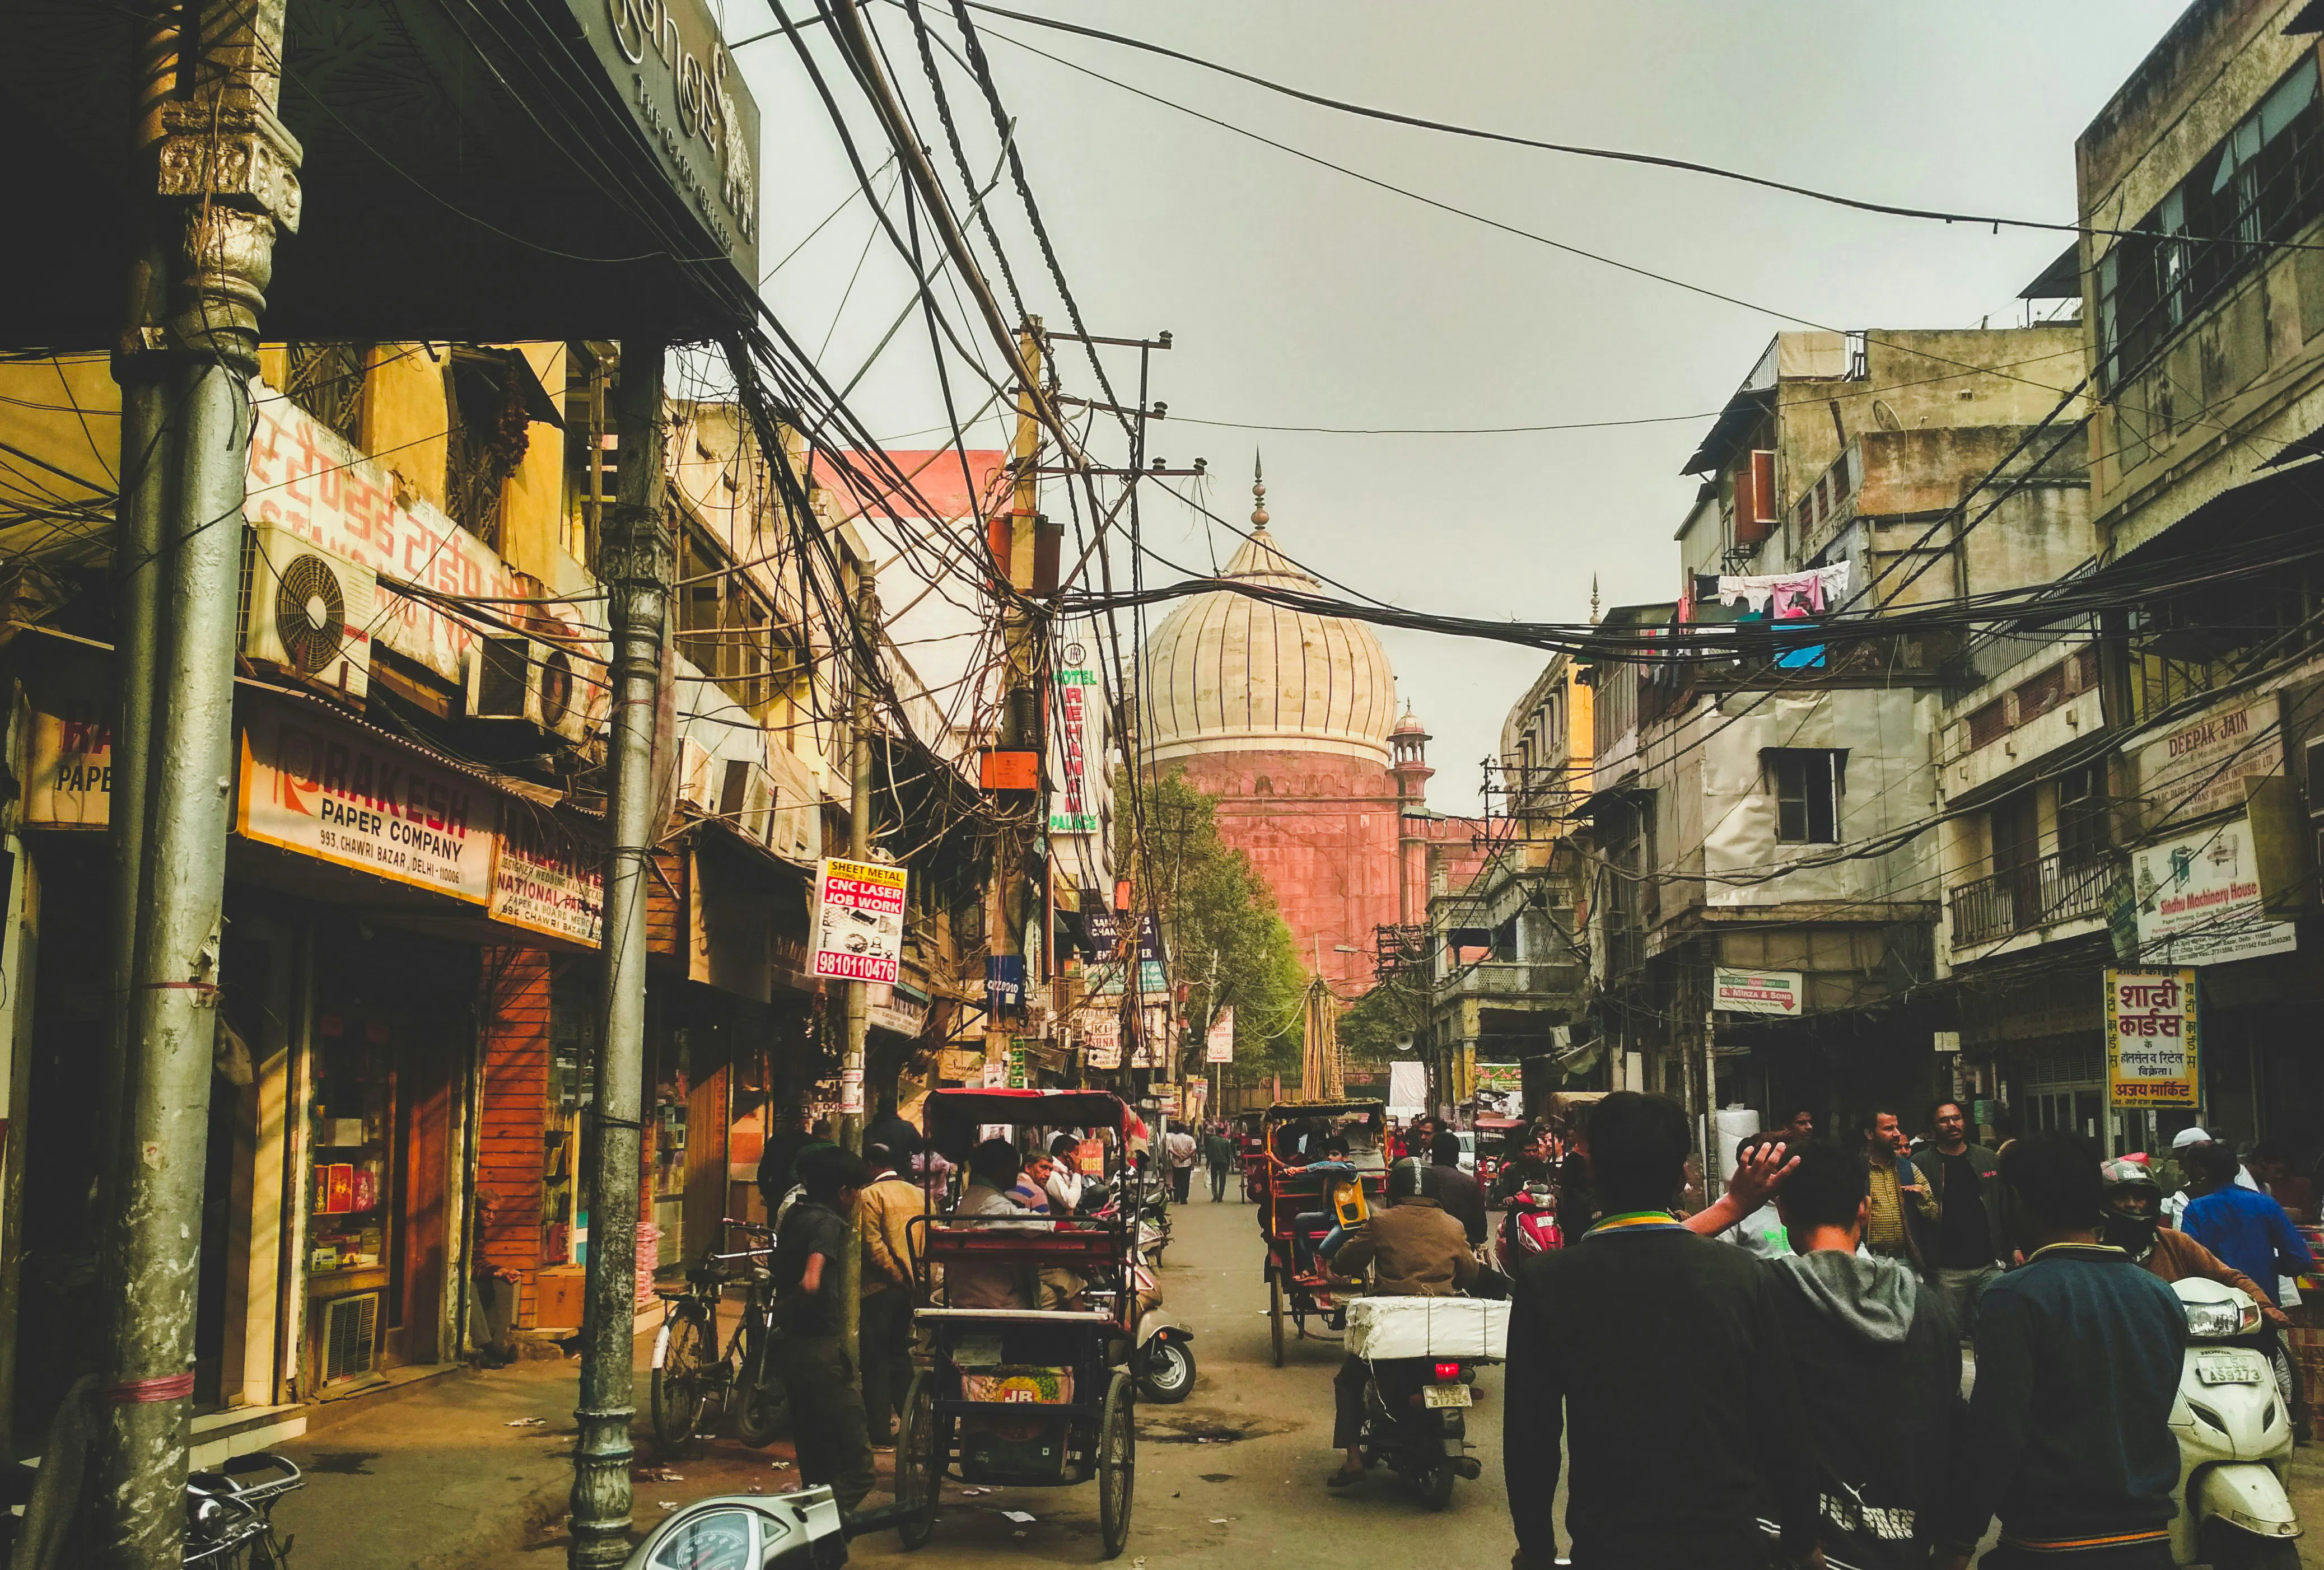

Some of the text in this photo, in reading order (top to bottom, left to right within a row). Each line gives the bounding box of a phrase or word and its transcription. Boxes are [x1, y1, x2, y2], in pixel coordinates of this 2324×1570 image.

[637, 74, 735, 259] THE CARD GALLERY
[2169, 709, 2248, 758] DEEPAK JAIN
[324, 739, 470, 839] RAKESH
[2211, 779, 2242, 798] INDUSTRIES
[321, 798, 382, 837] PAPER
[390, 820, 464, 863] COMPANY
[340, 835, 374, 859] CHAWRI
[501, 857, 534, 875] DESIGNER
[536, 868, 566, 889] WEDDING
[832, 862, 902, 882] SHEET METAL
[865, 877, 900, 887] FABRICATION
[497, 871, 559, 909] NATIONAL
[828, 879, 902, 900] CNC LASER
[2160, 882, 2258, 915] Sindhu Machinery House
[508, 895, 532, 912] PAPER
[542, 905, 567, 921] BOARD
[825, 892, 901, 914] JOB WORK
[525, 911, 560, 928] CHAWRI
[819, 952, 895, 981] 9810110476
[1733, 989, 1759, 998] MIRZA
[1770, 991, 1793, 1001] SONS
[2120, 979, 2181, 1008] शादी
[2118, 1008, 2183, 1038] कार्डस
[2144, 1039, 2153, 1049] के
[2150, 1053, 2157, 1064] व
[2115, 1080, 2191, 1097] अजय मार्किट
[2210, 1369, 2261, 1382] AS9273
[1004, 1390, 1034, 1403] JB
